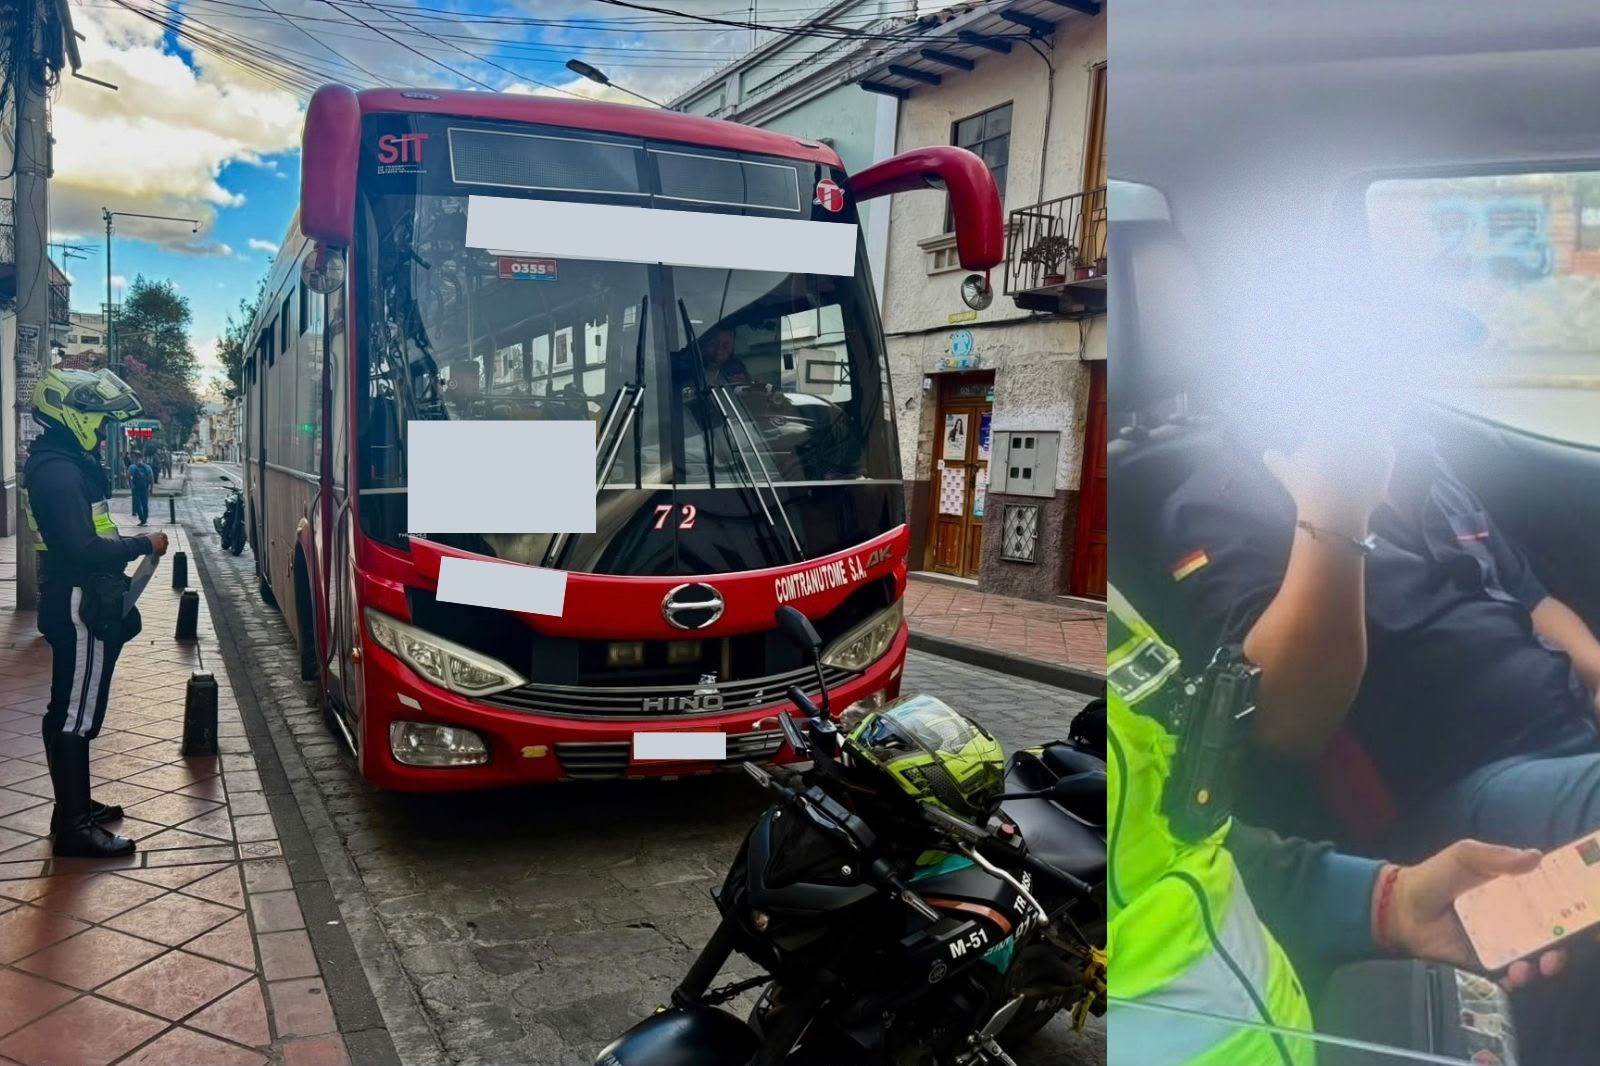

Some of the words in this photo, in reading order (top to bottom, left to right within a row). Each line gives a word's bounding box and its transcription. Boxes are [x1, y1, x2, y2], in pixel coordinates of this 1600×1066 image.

[378, 132, 430, 164] SIT
[511, 262, 546, 275] 0355
[641, 694, 724, 712] HINO
[948, 928, 989, 959] M-51
